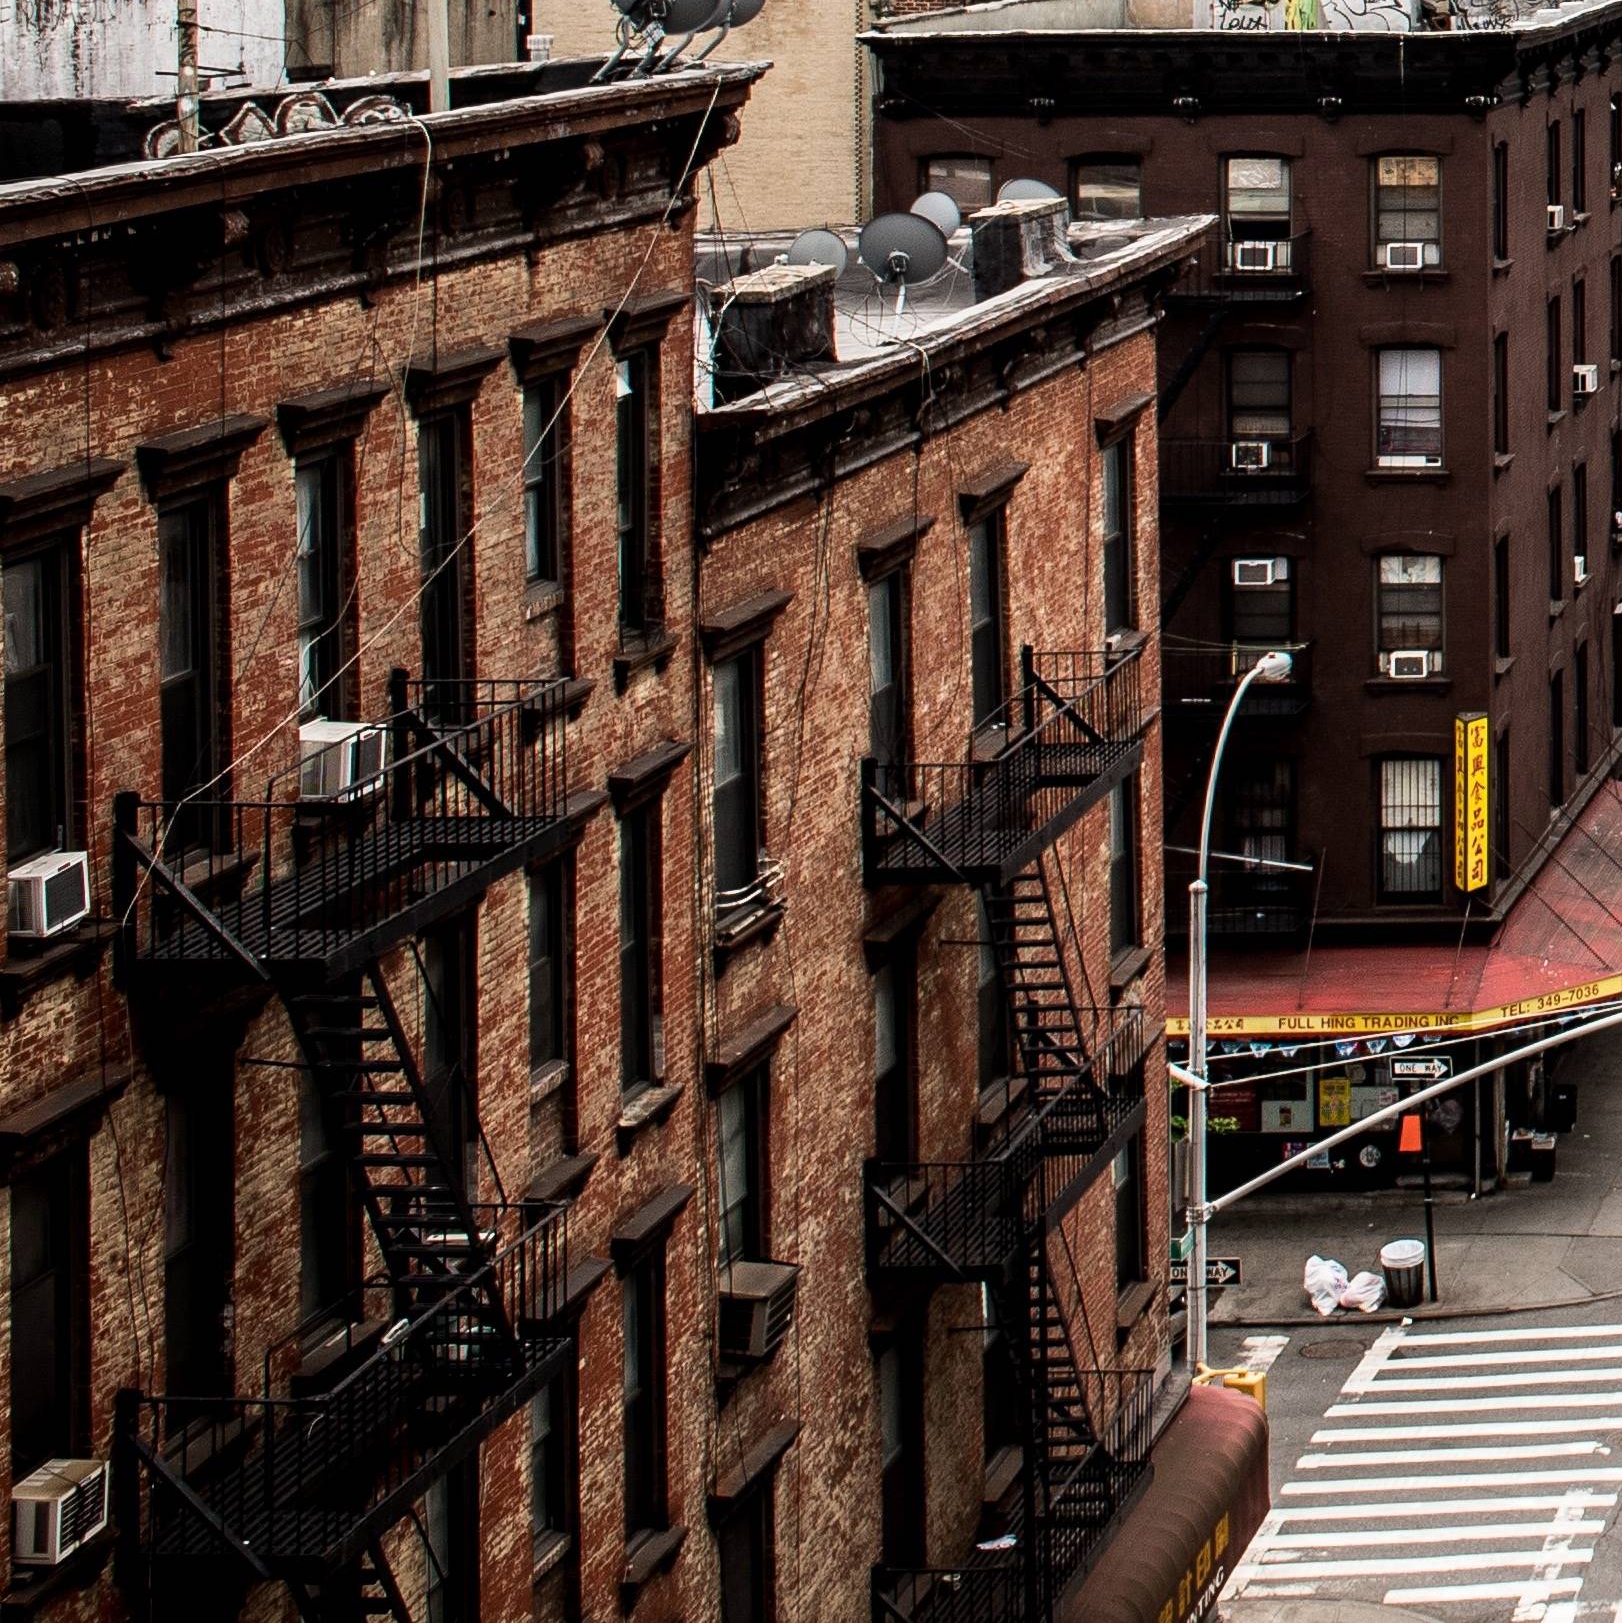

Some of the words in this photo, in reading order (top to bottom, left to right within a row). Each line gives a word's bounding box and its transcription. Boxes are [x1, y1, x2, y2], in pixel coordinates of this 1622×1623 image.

[1501, 1003, 1530, 1017] TEL:
[1537, 984, 1600, 1010] 349-7036
[1278, 1018, 1314, 1029] FULL
[1321, 1017, 1356, 1029] HING
[1361, 1016, 1430, 1028] TRADING
[1400, 1063, 1418, 1074] ONE
[1424, 1063, 1443, 1074] WAY
[1172, 1266, 1187, 1277] ON
